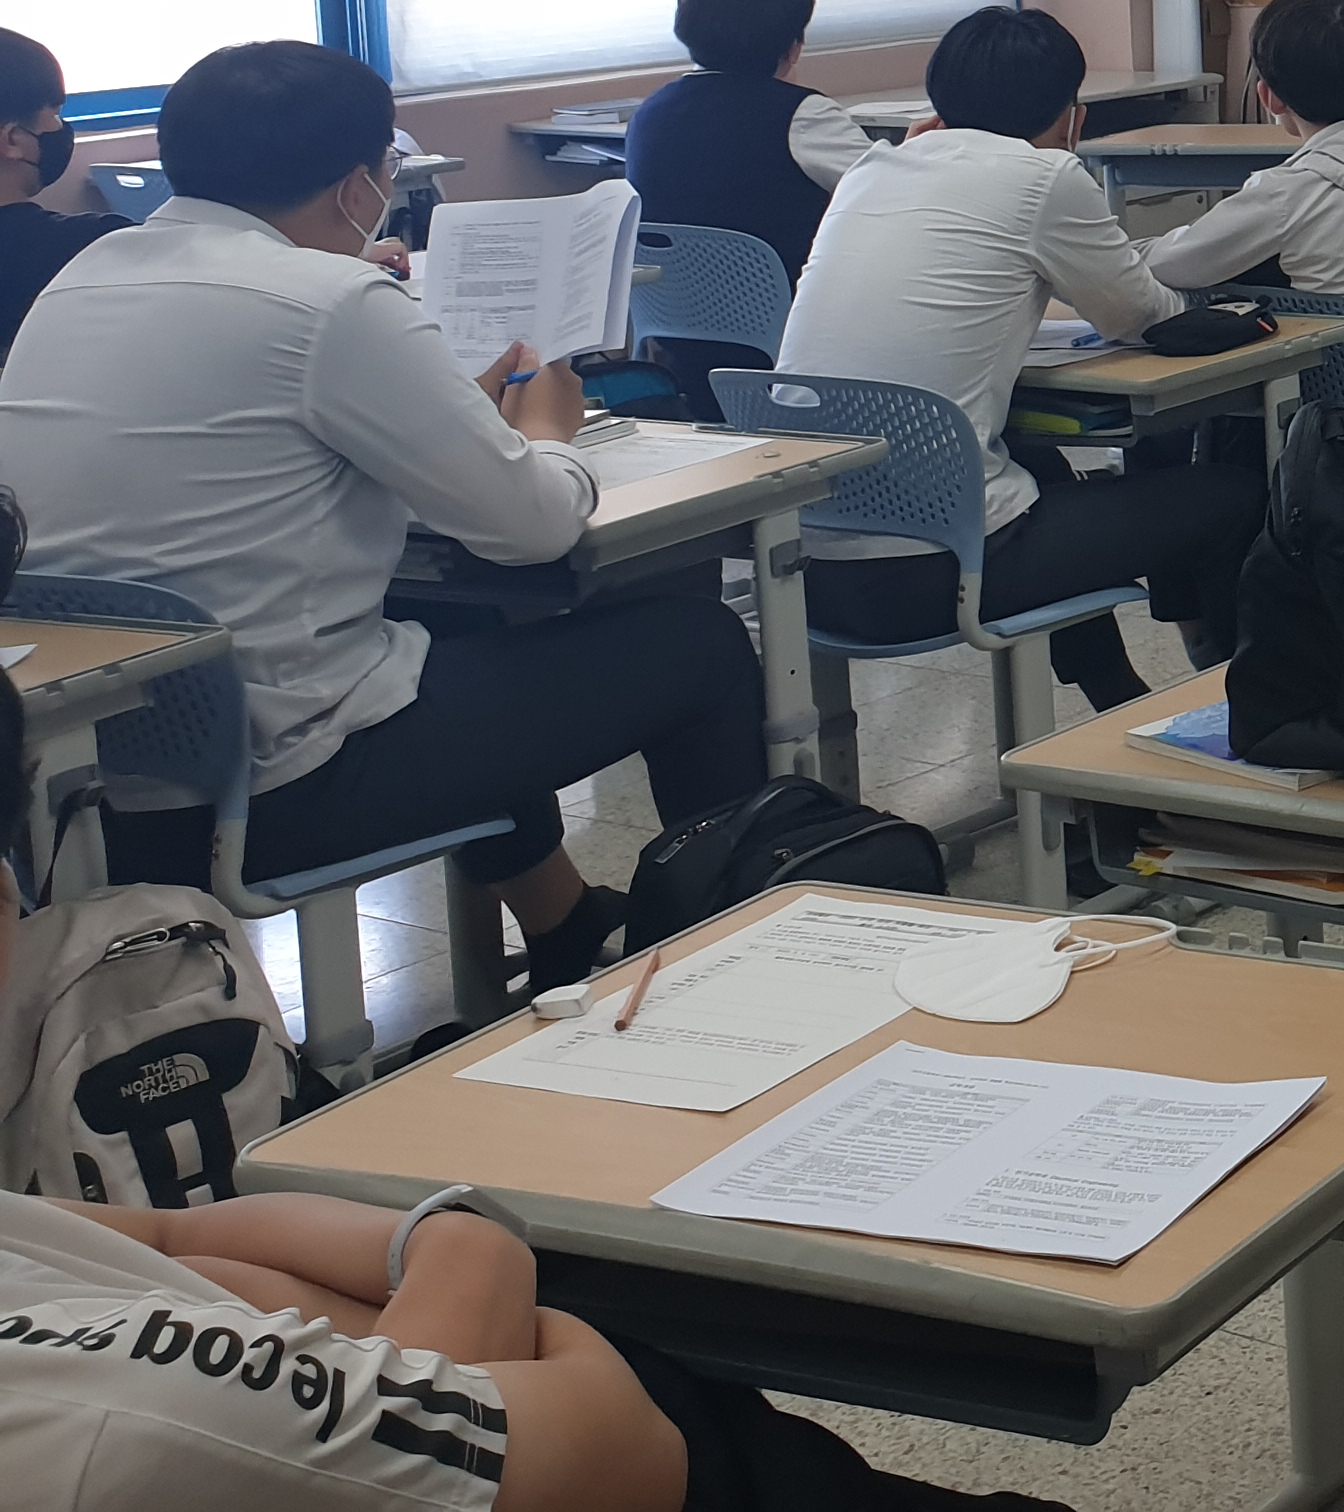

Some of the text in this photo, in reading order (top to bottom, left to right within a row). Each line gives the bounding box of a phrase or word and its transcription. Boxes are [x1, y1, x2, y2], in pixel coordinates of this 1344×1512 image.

[139, 1056, 175, 1077] THE
[120, 1068, 178, 1098] NORTH
[140, 1079, 181, 1104] FACE
